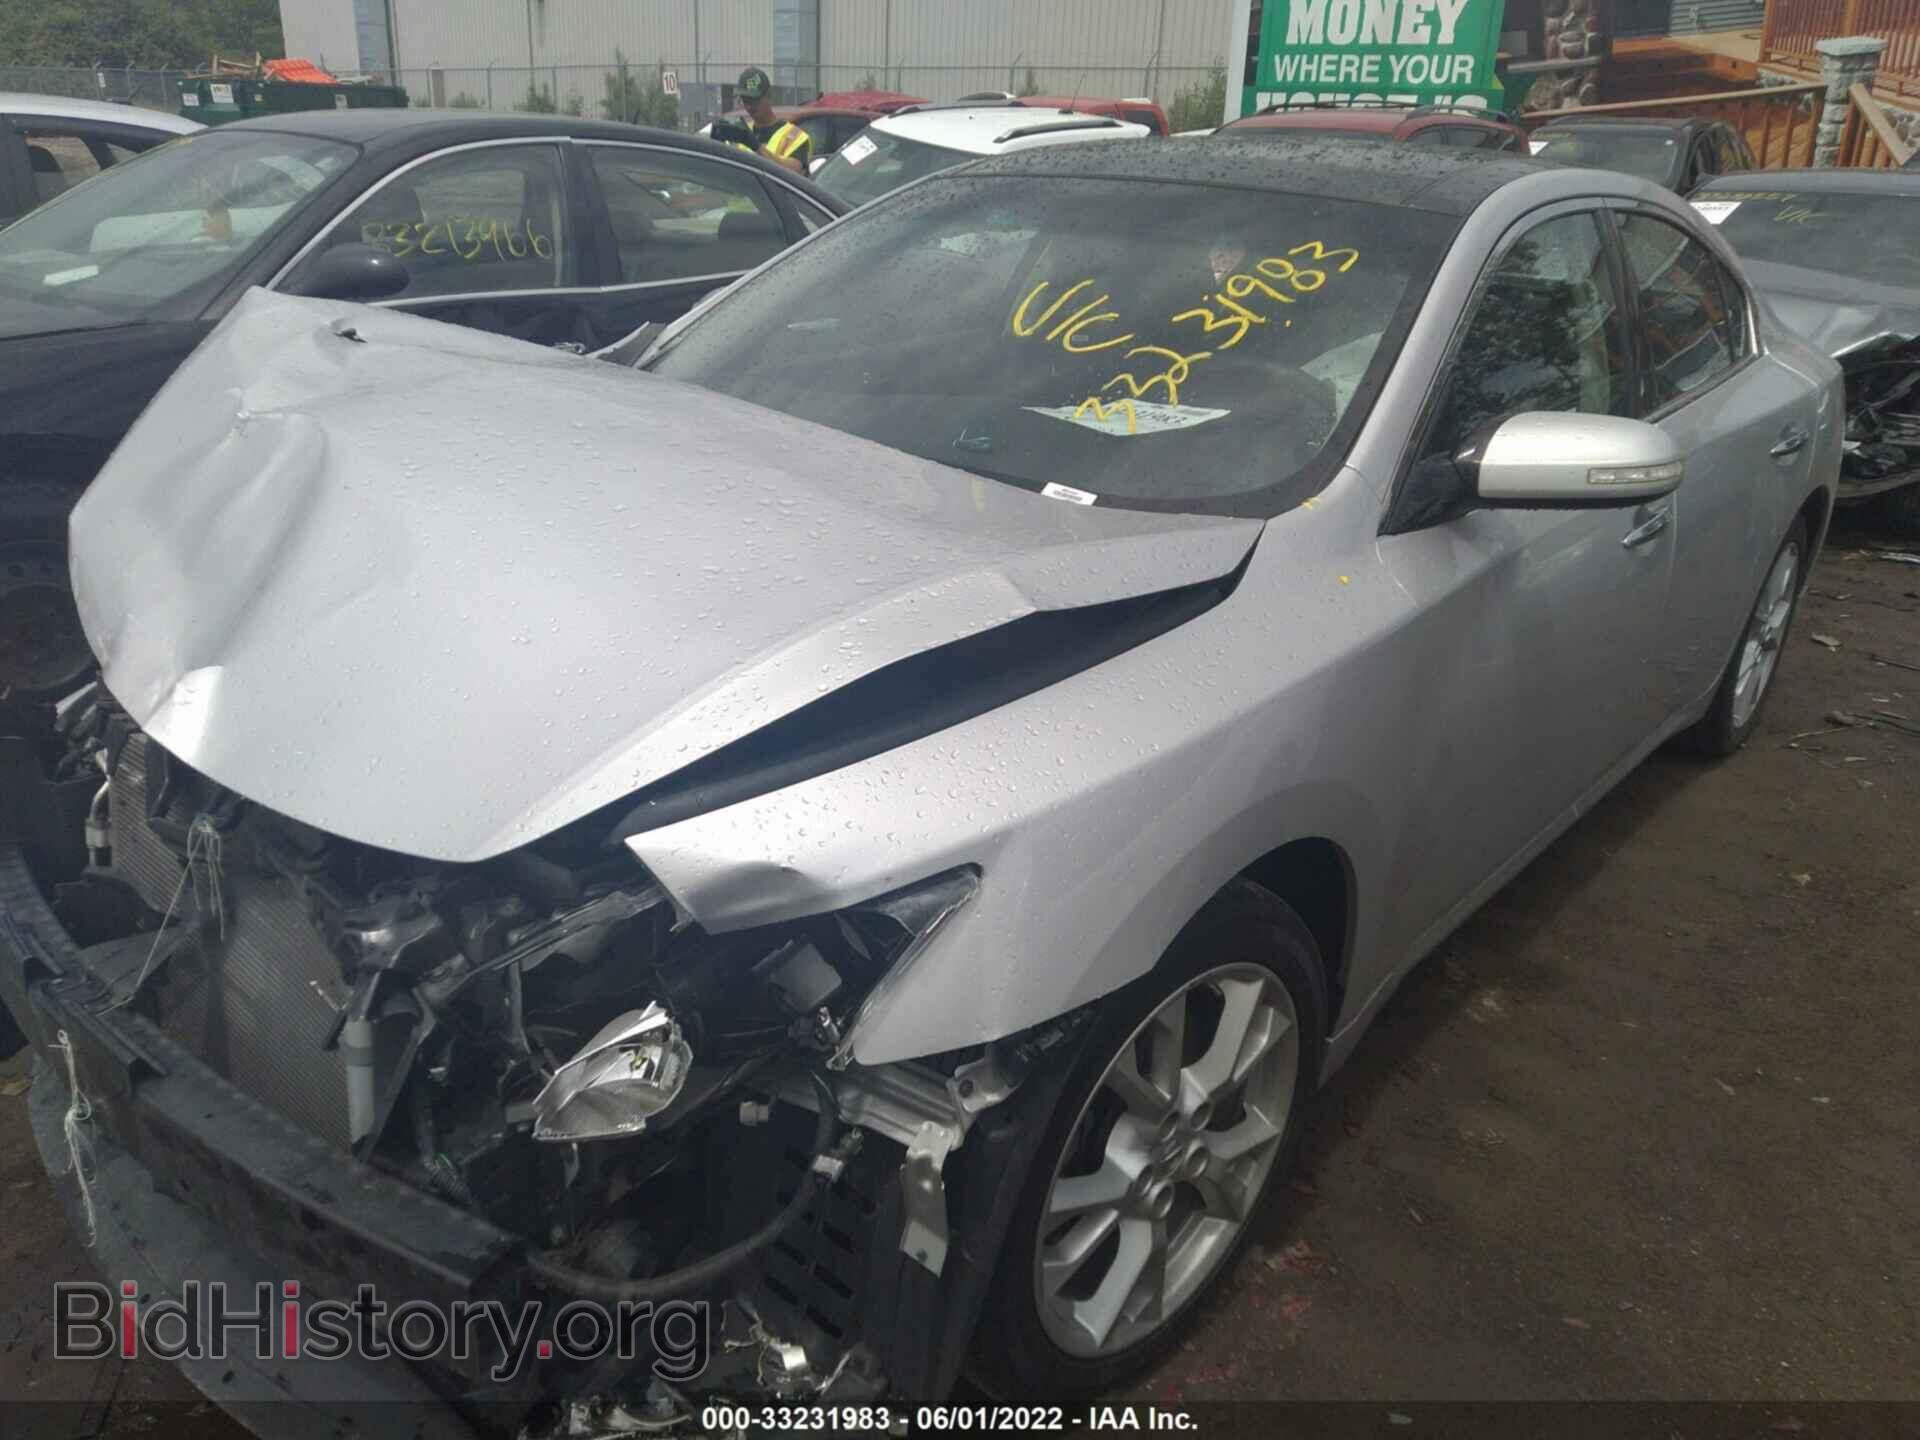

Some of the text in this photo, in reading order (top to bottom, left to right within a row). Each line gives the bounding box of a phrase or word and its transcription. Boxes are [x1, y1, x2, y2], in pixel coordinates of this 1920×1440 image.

[1285, 0, 1468, 46] MONEY
[665, 73, 678, 91] 10
[1274, 54, 1476, 85] WHERE YOUR
